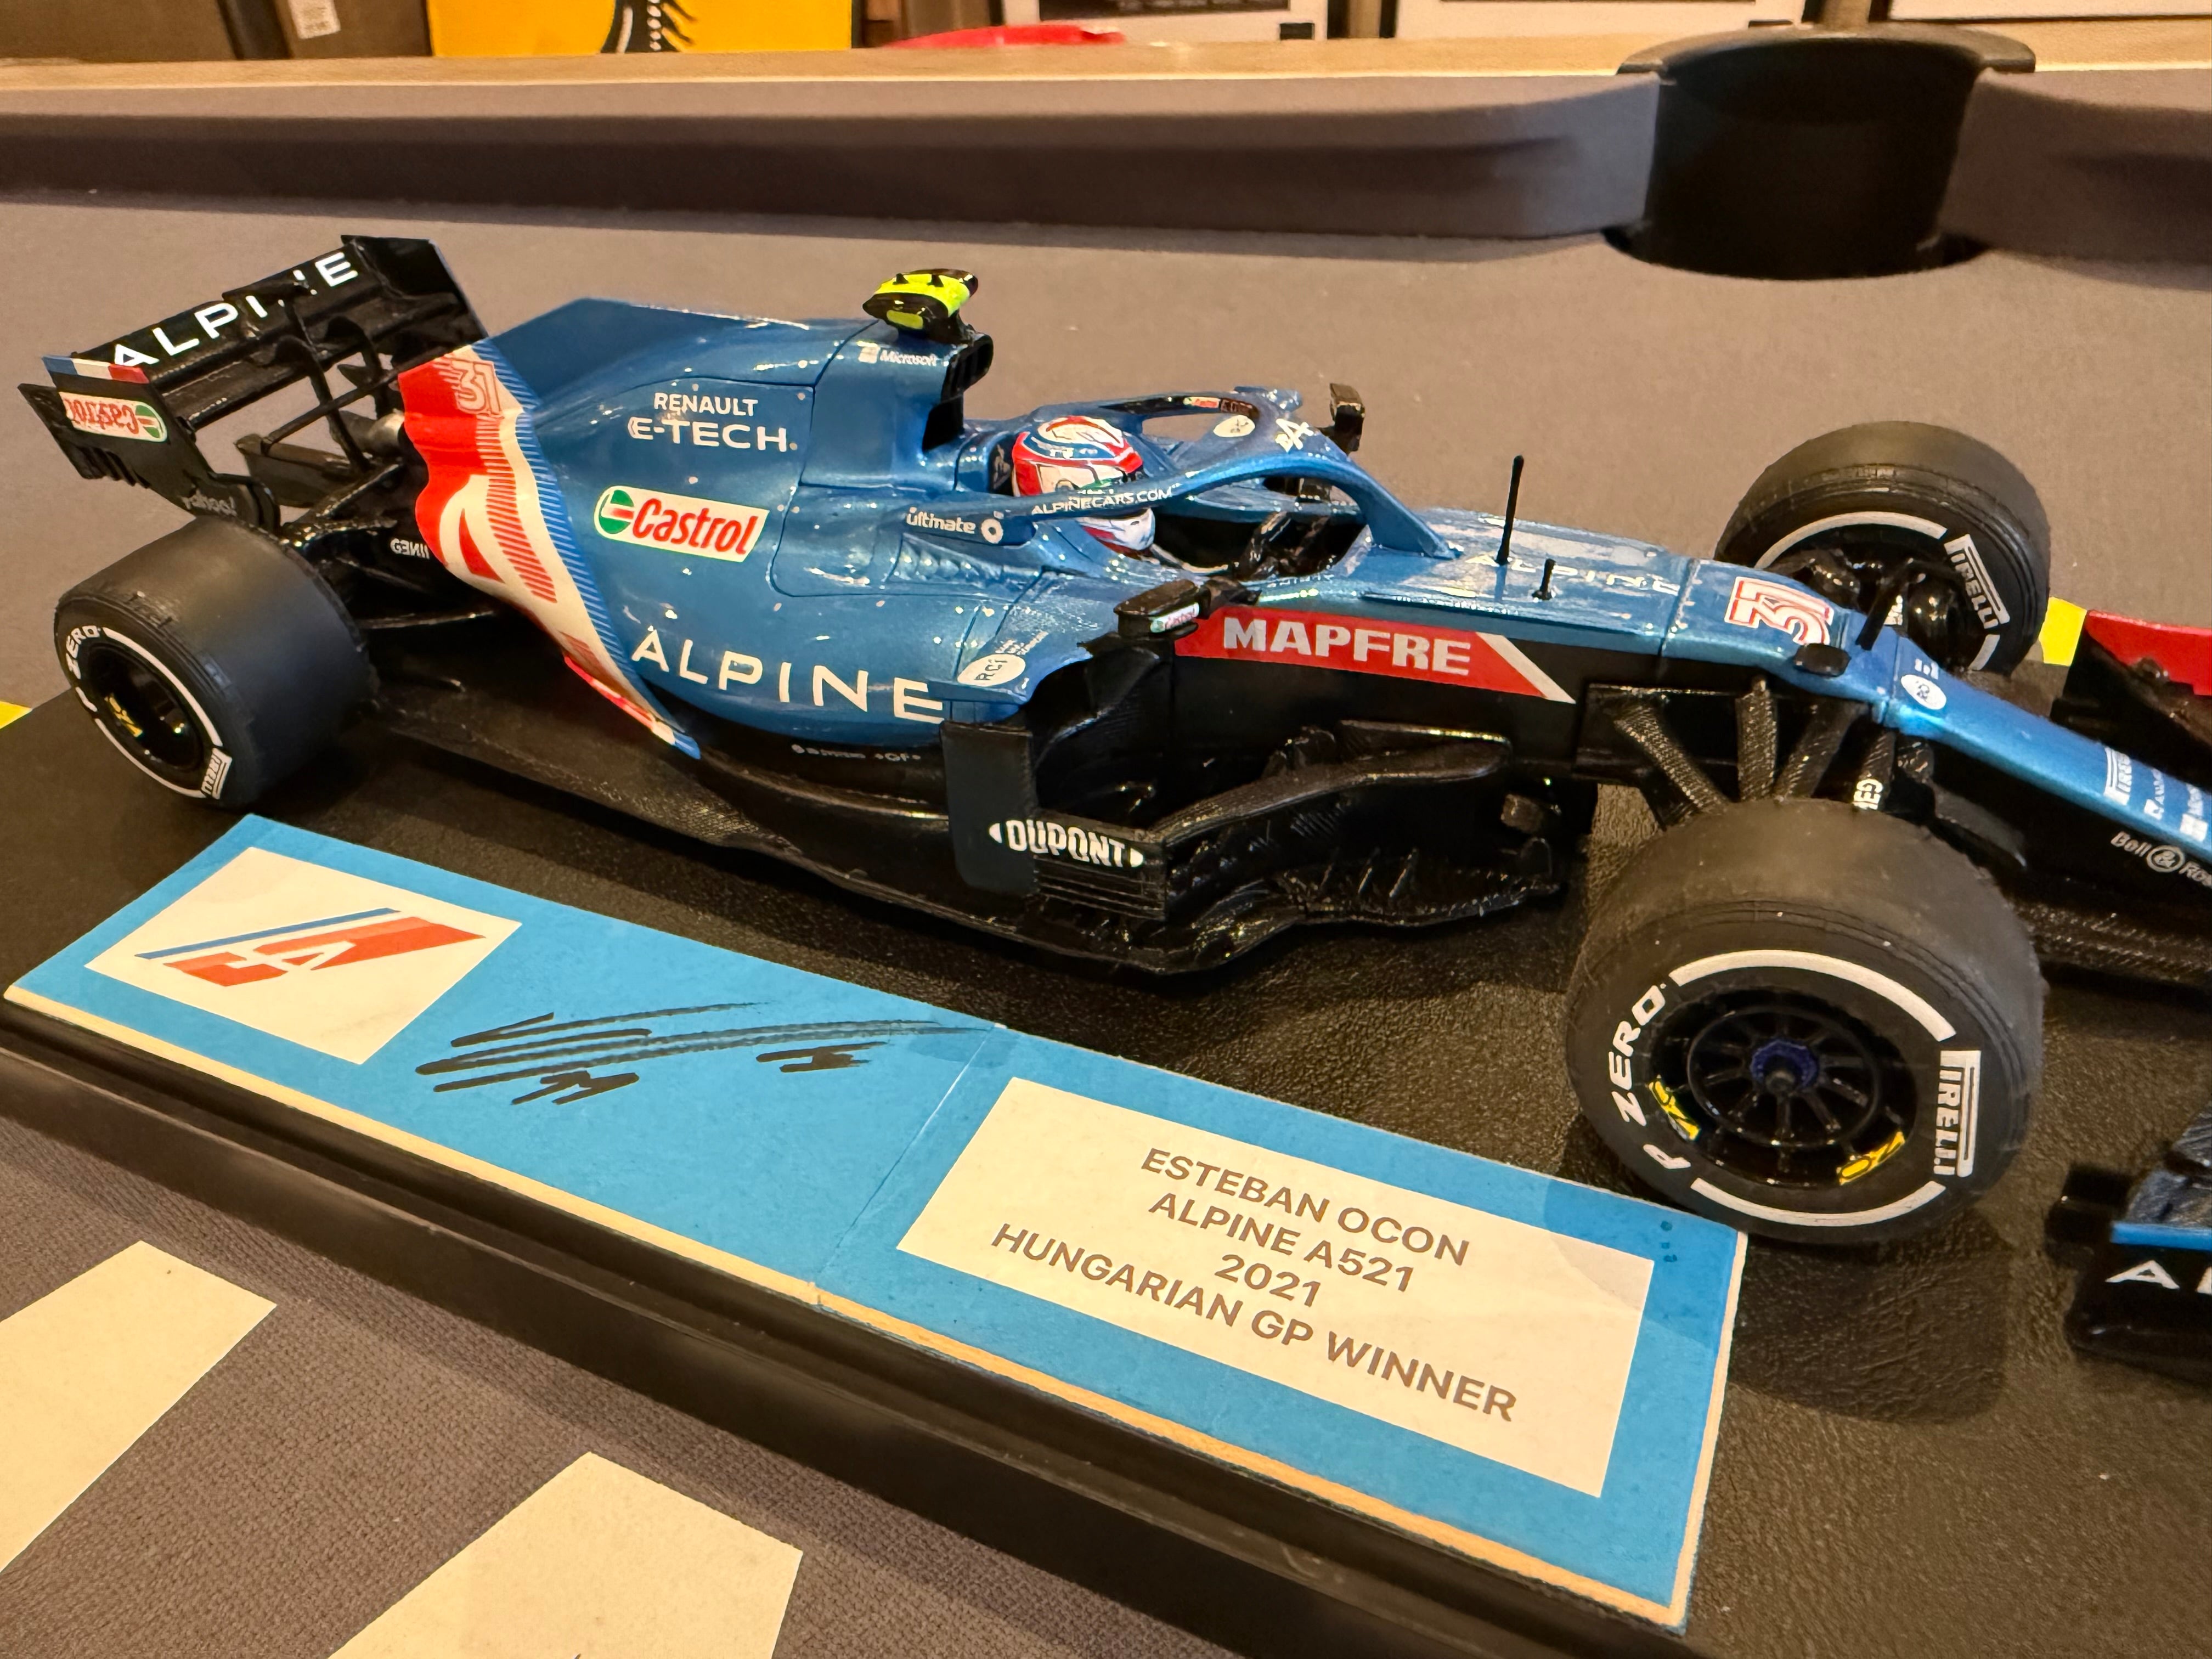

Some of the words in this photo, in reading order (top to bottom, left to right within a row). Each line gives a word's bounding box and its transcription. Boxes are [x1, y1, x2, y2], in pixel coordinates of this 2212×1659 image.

[653, 392, 759, 417] RENAULT
[632, 498, 759, 555] Castrol
[906, 507, 977, 534] ultimate
[65, 624, 100, 680] ZERO
[632, 628, 945, 724] ALPINE
[1223, 617, 1471, 676] MAPFRE
[1006, 819, 1126, 867] DUPONT
[1607, 985, 1666, 1127] ZERO
[1933, 1050, 1982, 1178] PIRELLI
[1141, 1148, 1330, 1222] ESTEBAN
[1338, 1207, 1470, 1266] OCON
[1148, 1193, 1301, 1255] ALPINE
[1304, 1240, 1414, 1292] A521
[1214, 1254, 1321, 1308] 2021
[991, 1223, 1244, 1327] HUNGARIAN
[1251, 1310, 1314, 1346] GP
[1328, 1331, 1516, 1422] WINNER
